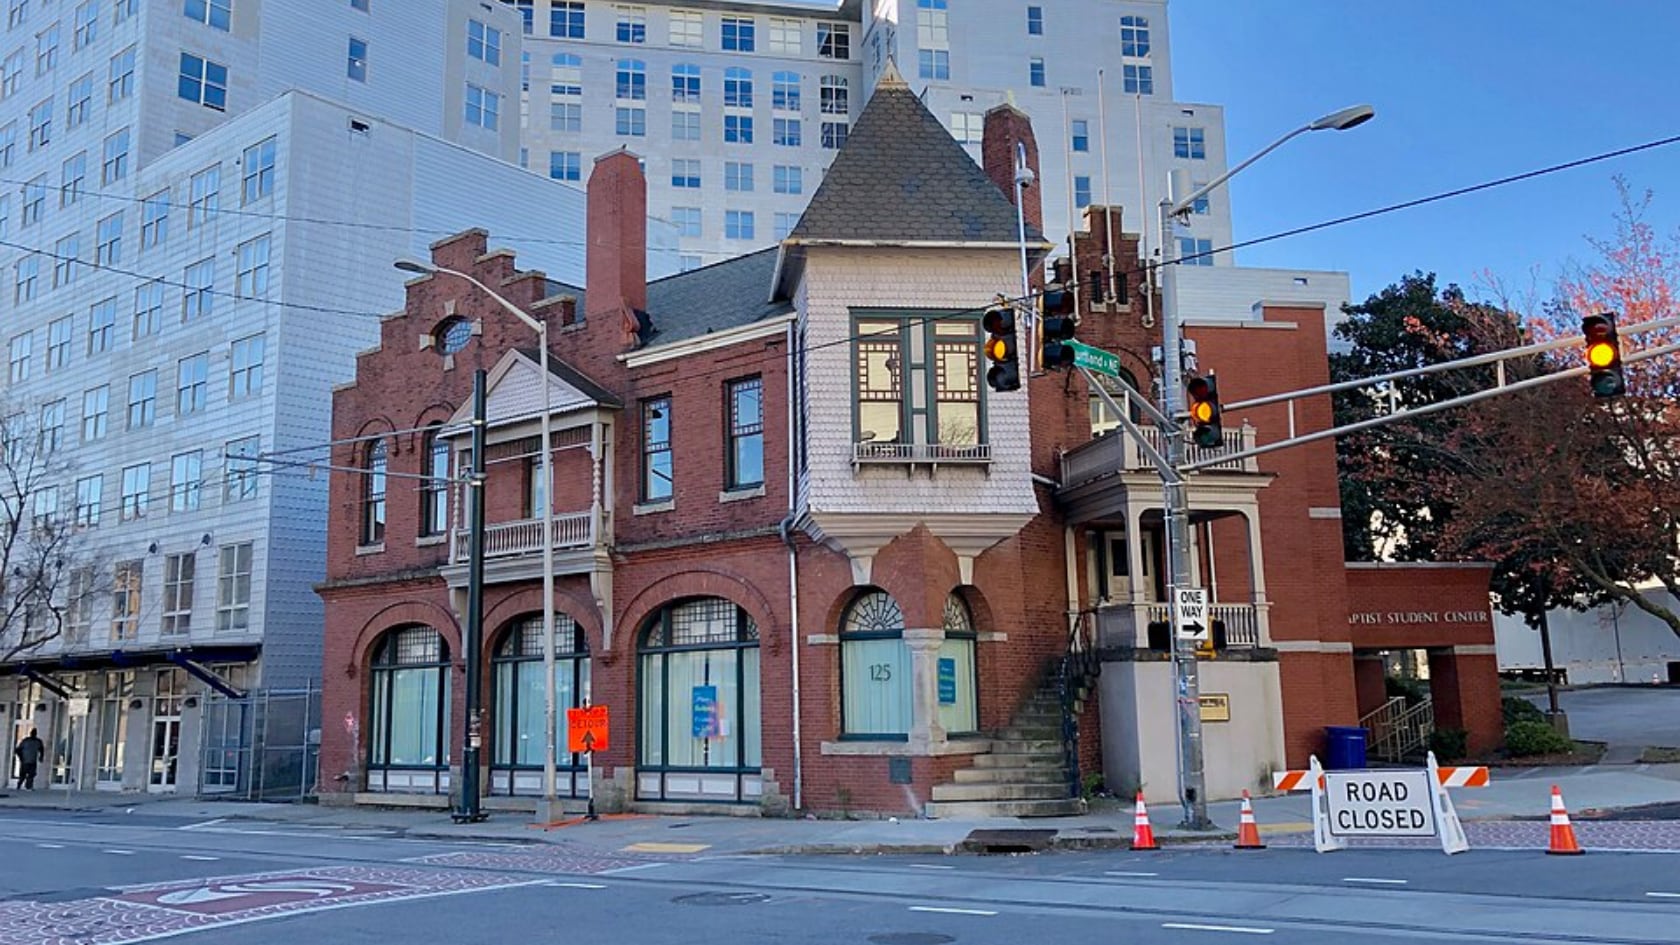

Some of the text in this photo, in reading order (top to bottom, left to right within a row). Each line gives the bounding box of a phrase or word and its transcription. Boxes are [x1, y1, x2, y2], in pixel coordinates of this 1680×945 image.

[1181, 591, 1202, 604] ONE
[1181, 605, 1203, 618] WAY
[1387, 611, 1438, 623] STUDENT
[1443, 610, 1488, 622] CENTER
[868, 663, 891, 681] 125
[1346, 782, 1408, 801] ROAD
[1338, 809, 1425, 829] CLOSED
